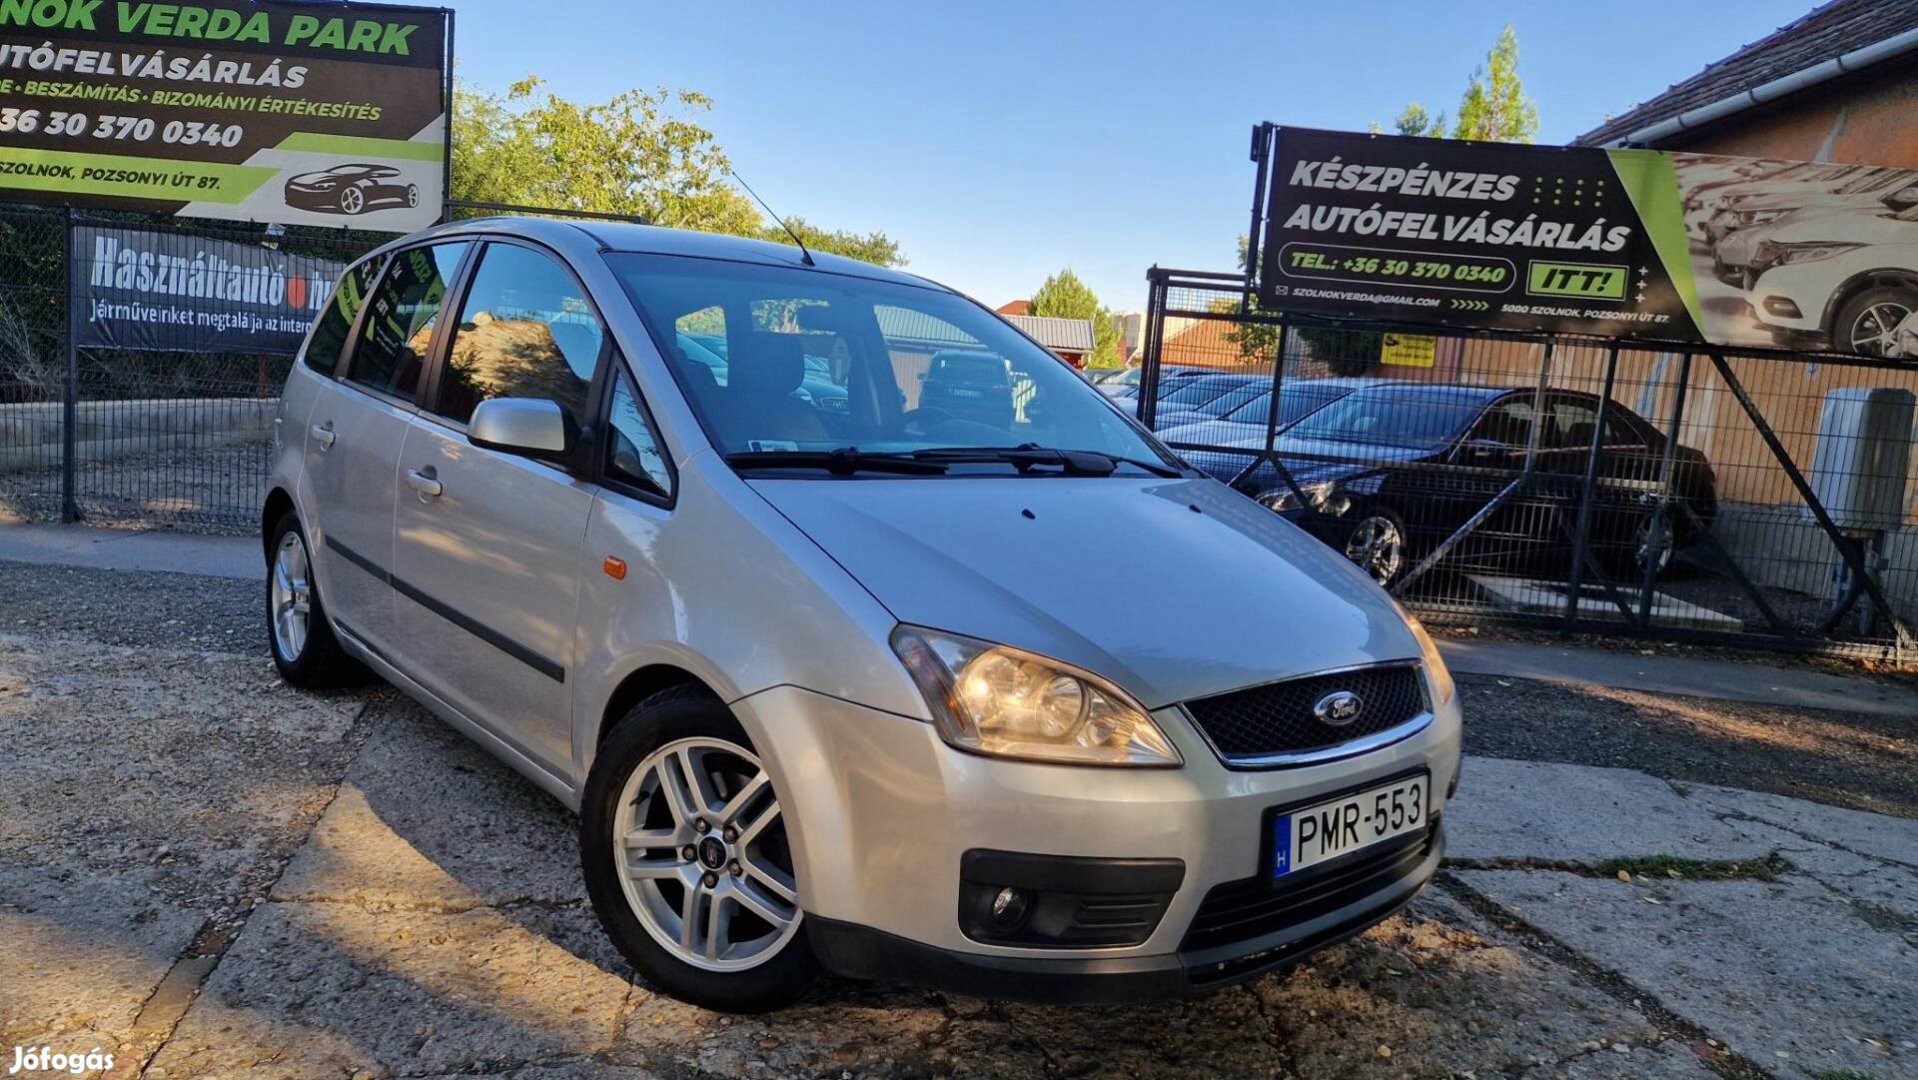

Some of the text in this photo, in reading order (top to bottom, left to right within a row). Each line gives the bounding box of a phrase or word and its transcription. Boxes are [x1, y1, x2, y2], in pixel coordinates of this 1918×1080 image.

[0, 0, 419, 56] NOK VERDA PARK
[24, 79, 141, 104] BESZÁMÍTÁS
[152, 89, 262, 113] BIZOMÁNYI
[258, 96, 382, 122] ÉRTÉKESÍTÉS
[44, 111, 87, 136] 30
[92, 115, 155, 142] 370
[162, 120, 244, 149] 0340
[81, 166, 168, 186] POZSONYI
[171, 171, 194, 188] ÚT
[197, 176, 220, 190] 87.
[1289, 155, 1521, 201] KÉSZPÉNZES
[1282, 202, 1631, 252] AUTÓFELVÁSÁRLÁS
[1290, 251, 1506, 283] TEL.: +36 30 370 0340
[1541, 268, 1613, 292] ITT!
[1292, 287, 1441, 308] SZOLNOKVERDA@GMAIL.COM
[1501, 303, 1529, 314] 5000
[1583, 309, 1637, 320] POZSONYI
[1639, 311, 1655, 322] ÚT
[1332, 699, 1355, 718] Ford
[1297, 783, 1422, 863] PMR-553
[1276, 850, 1287, 869] H
